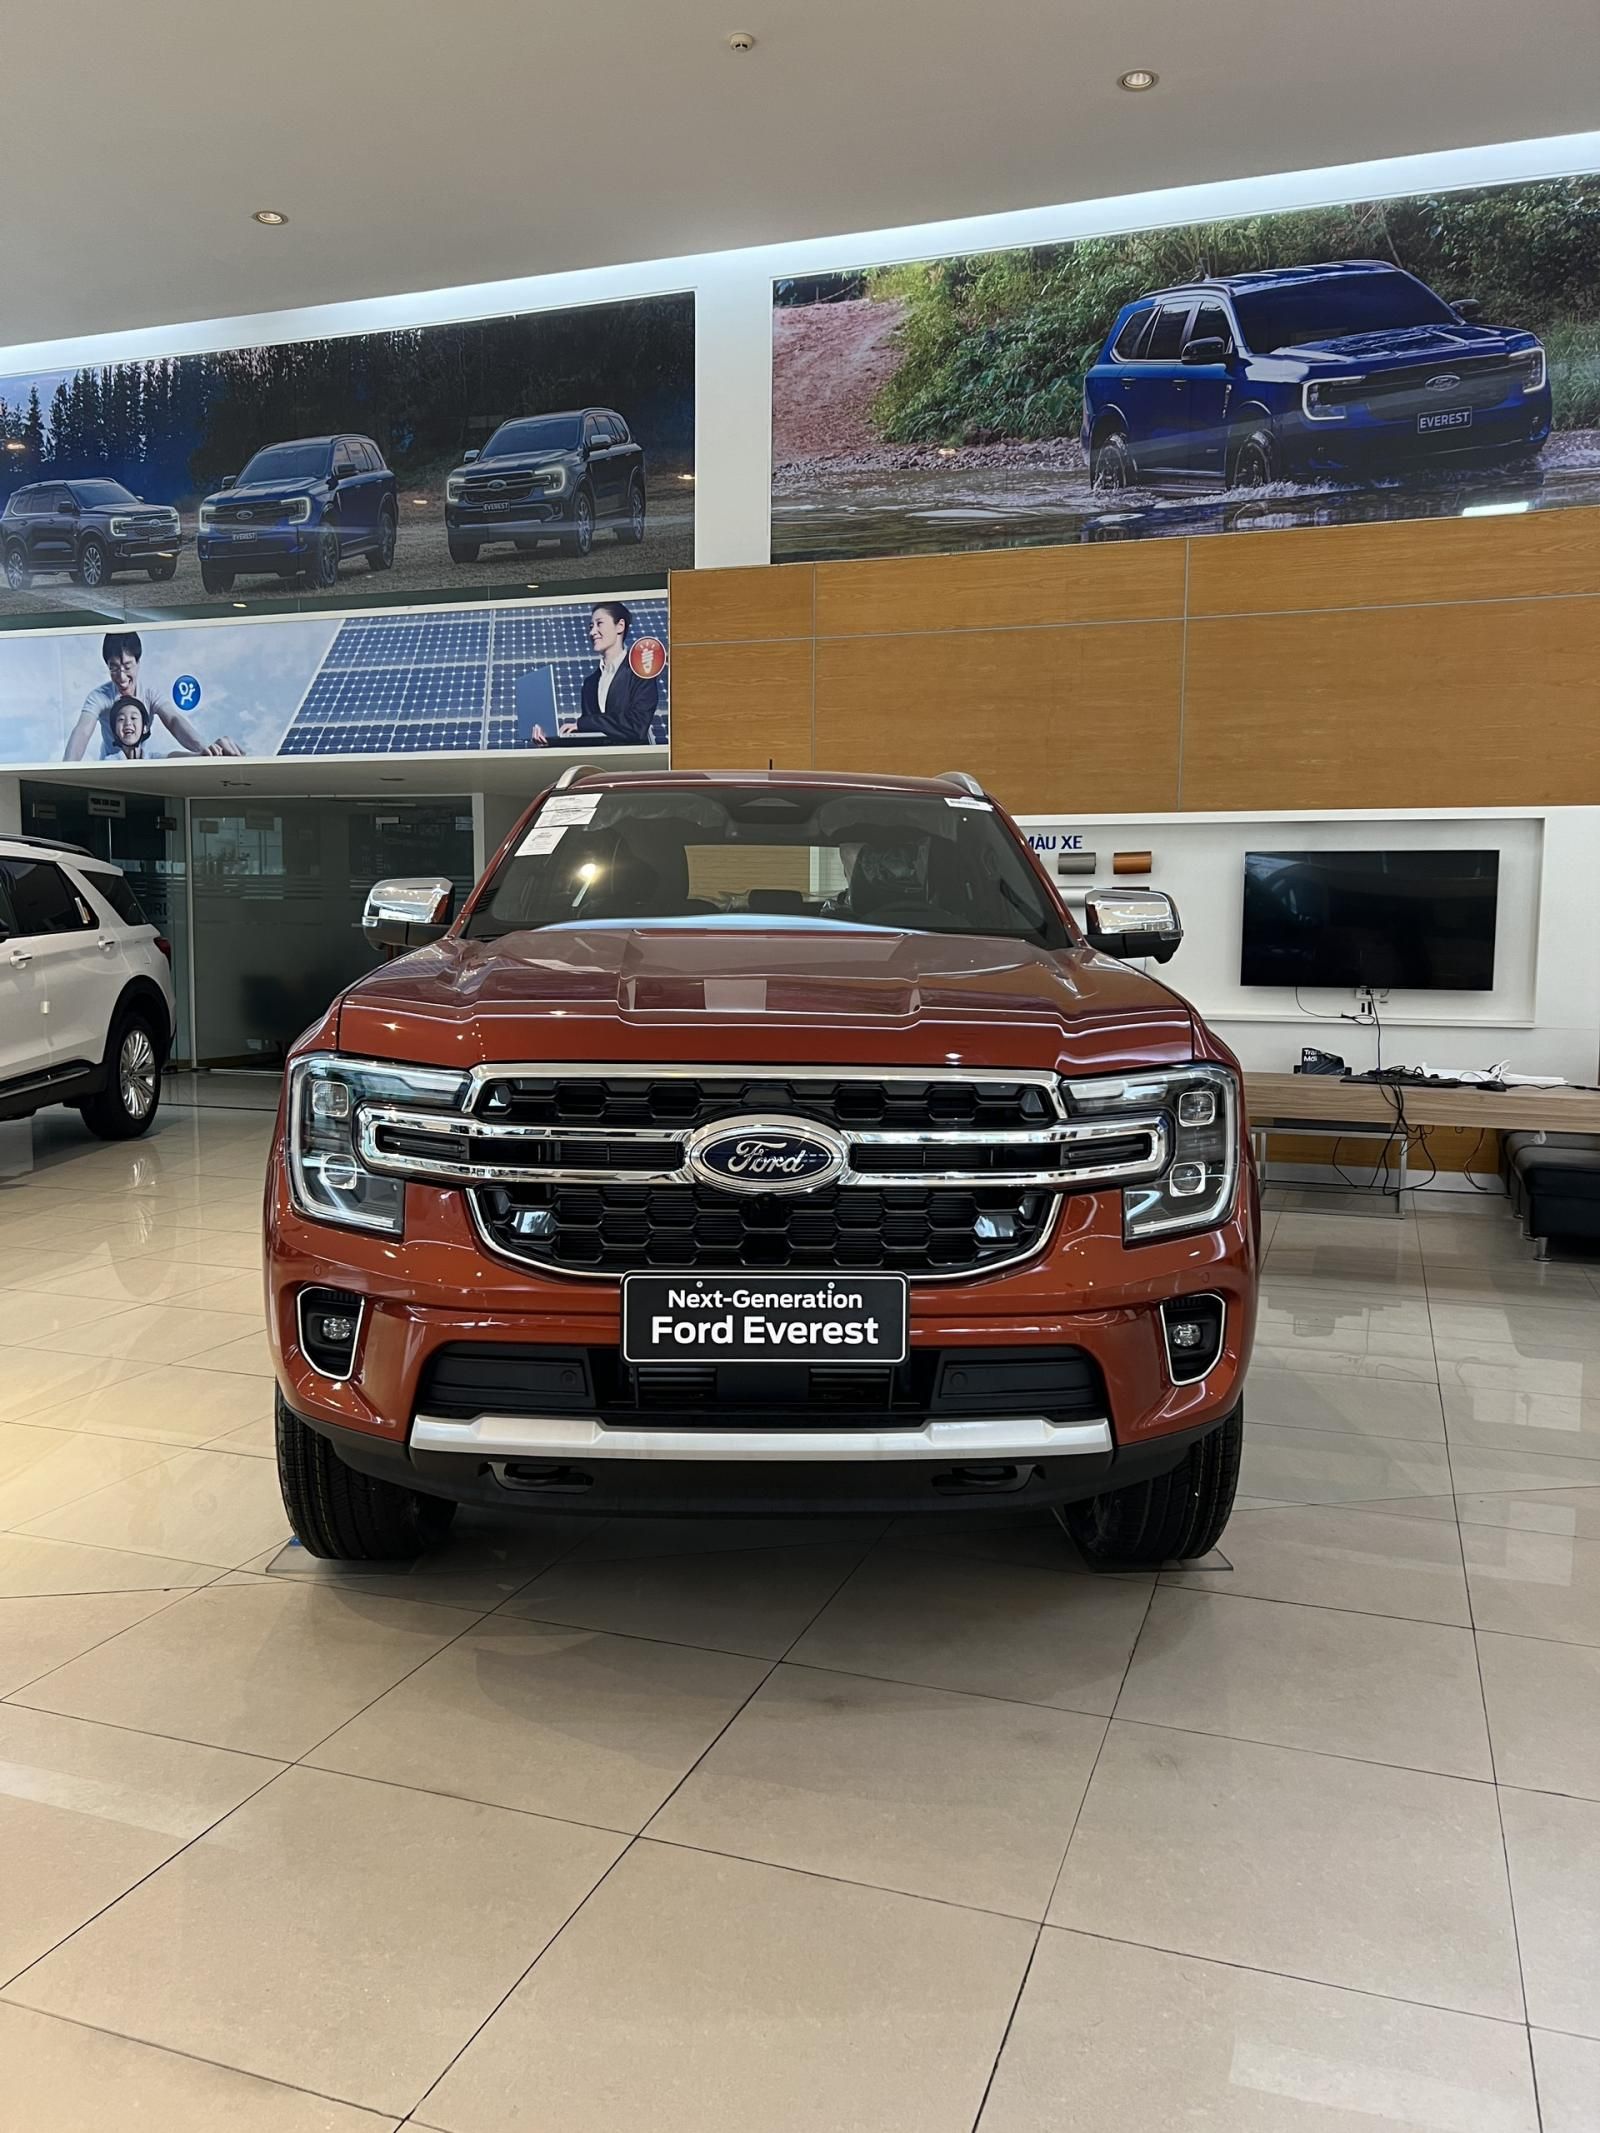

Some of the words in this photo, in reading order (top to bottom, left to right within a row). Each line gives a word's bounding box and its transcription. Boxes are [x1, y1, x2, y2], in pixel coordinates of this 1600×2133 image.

[1420, 412, 1469, 428] EVEREST
[1060, 835, 1083, 850] XE
[727, 1140, 806, 1173] Ford
[668, 1288, 863, 1309] Next-Generation
[652, 1315, 734, 1345] Ford
[743, 1316, 880, 1345] Everest
